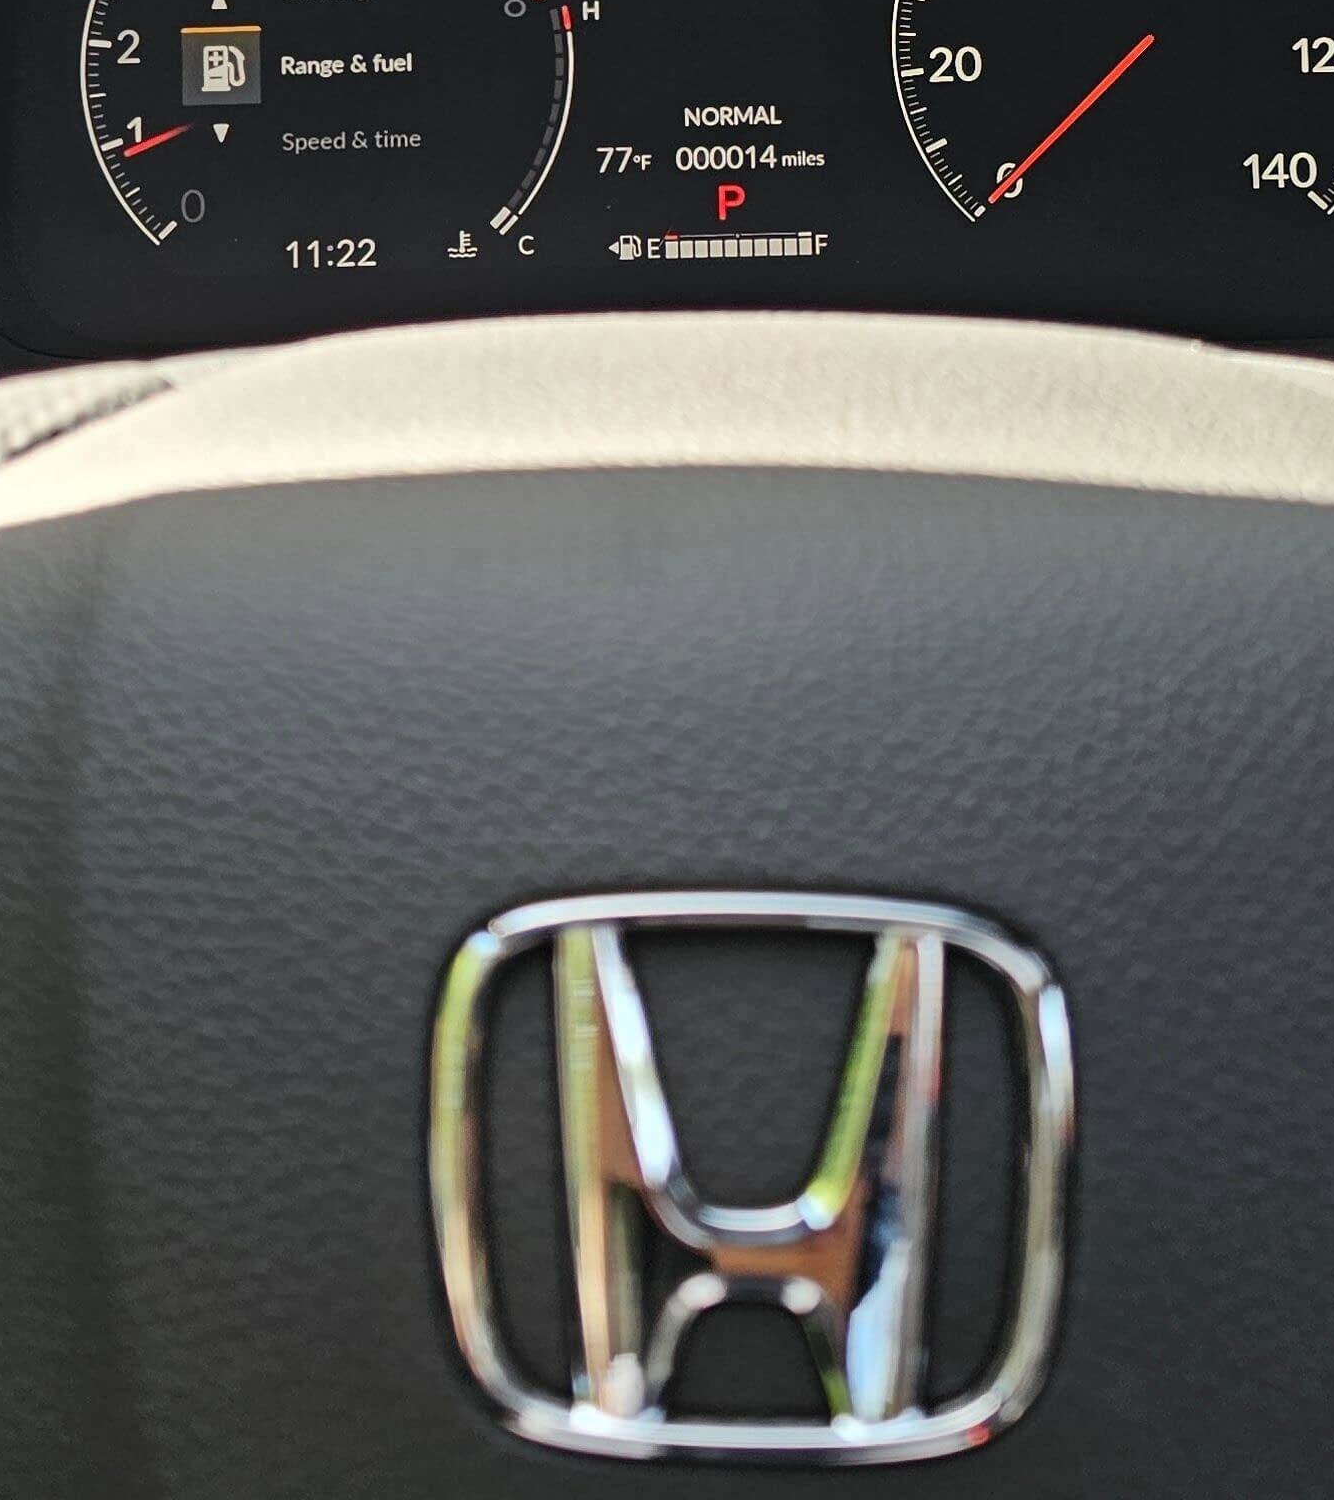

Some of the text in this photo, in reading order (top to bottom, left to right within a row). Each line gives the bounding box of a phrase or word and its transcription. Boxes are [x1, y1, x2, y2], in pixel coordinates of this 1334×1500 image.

[582, 0, 600, 21] H
[116, 29, 141, 64] 2
[280, 52, 414, 78] Range & fuel
[928, 45, 983, 83] 20
[683, 105, 783, 127] NORMAL
[126, 116, 142, 144] 1
[282, 129, 423, 155] Speed & time
[675, 144, 778, 171] 000014
[780, 150, 827, 168] miles
[1242, 151, 1319, 190] 140
[180, 189, 206, 223] 0
[718, 184, 747, 221] P
[284, 238, 378, 270] 11:22
[518, 234, 535, 256] C
[647, 238, 662, 259] E
[815, 234, 829, 255] F
